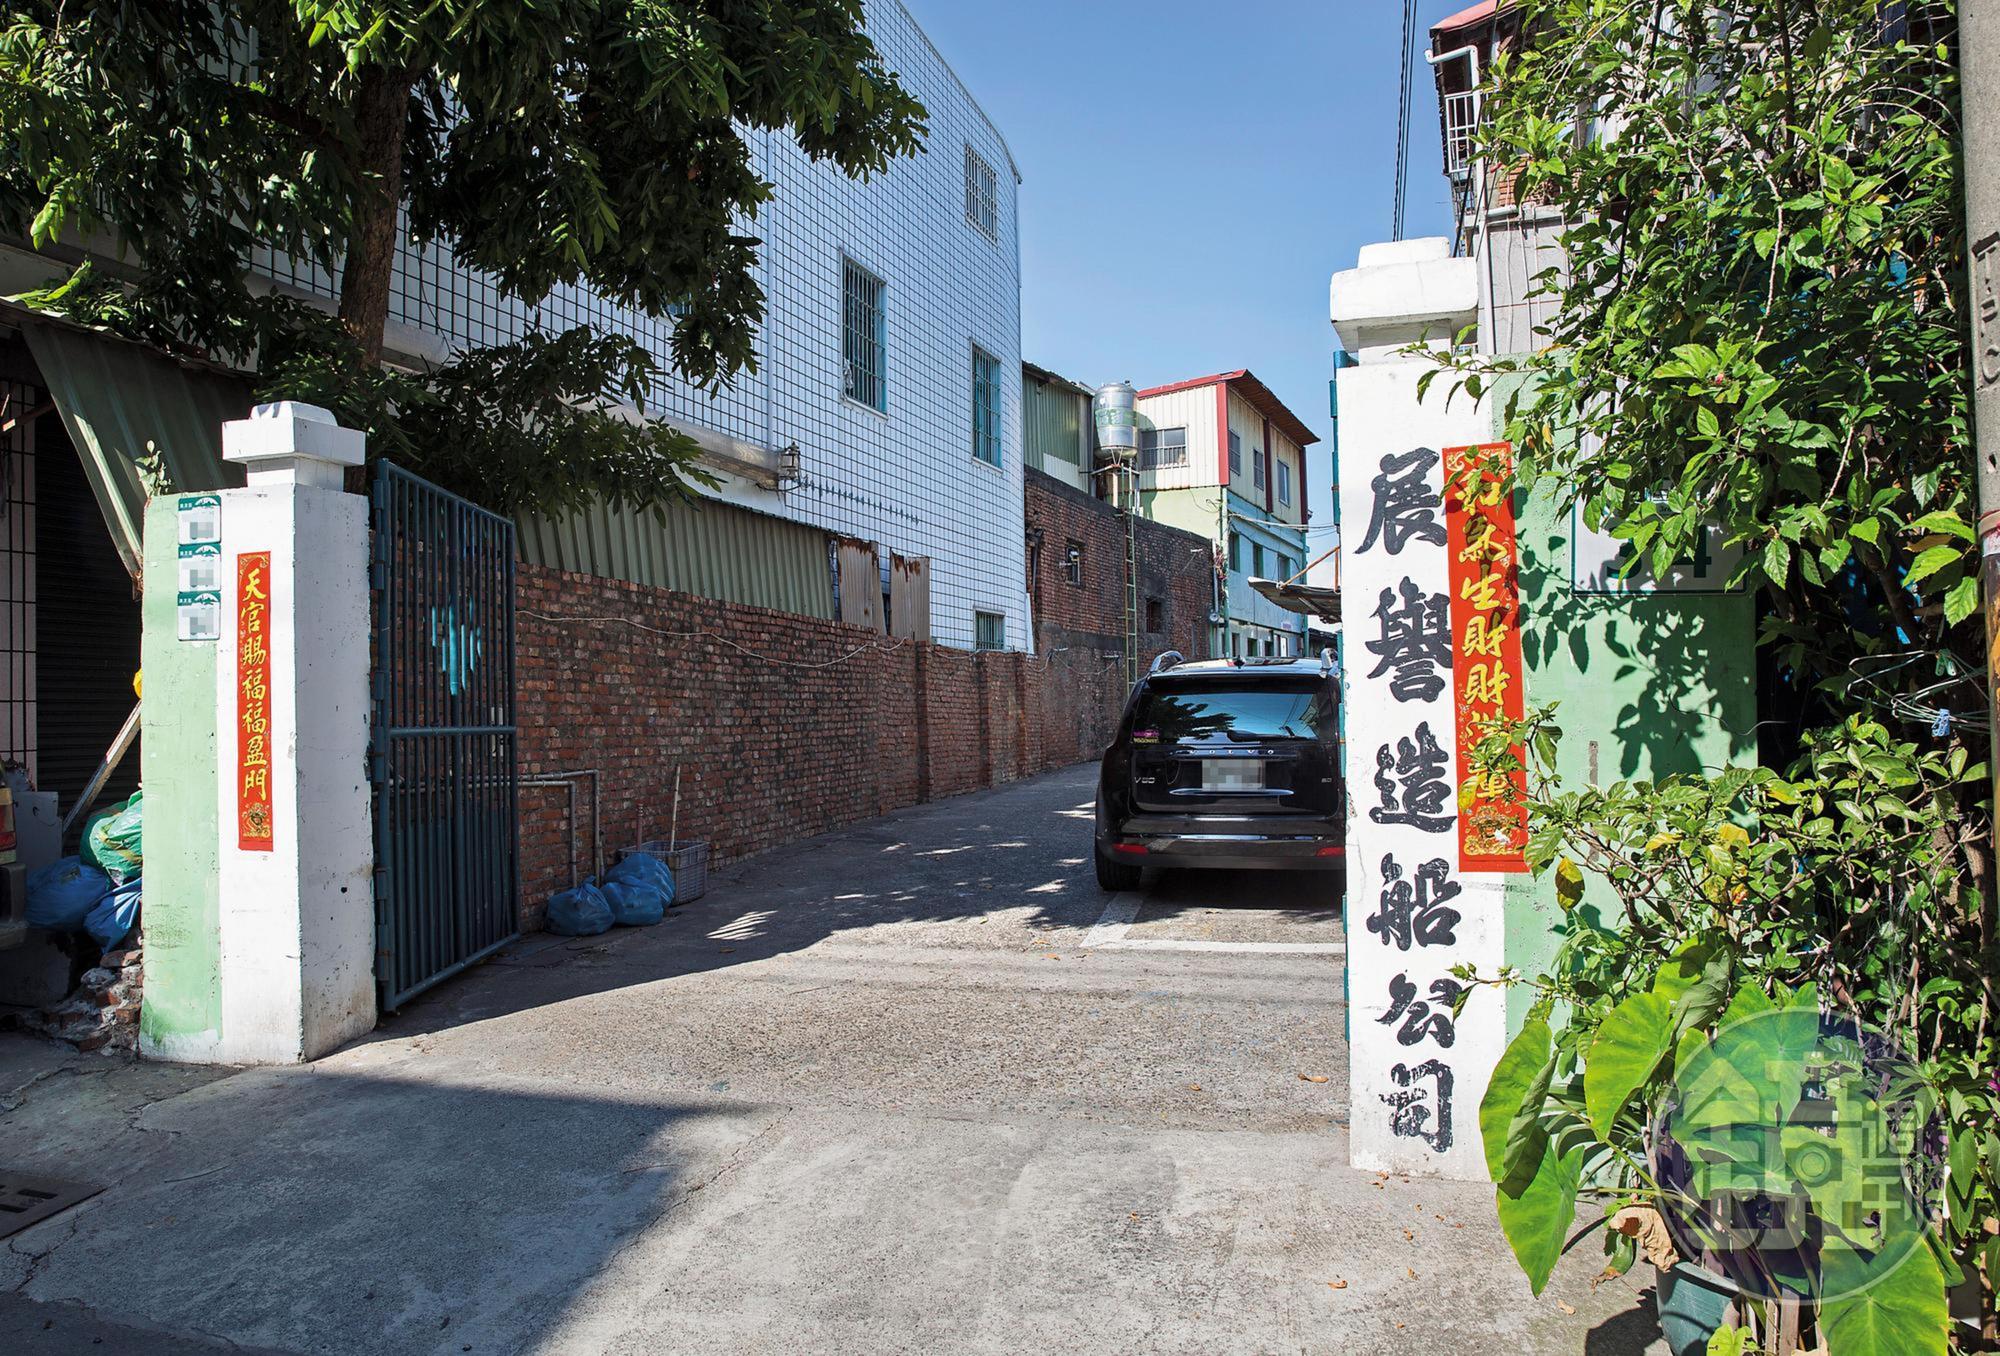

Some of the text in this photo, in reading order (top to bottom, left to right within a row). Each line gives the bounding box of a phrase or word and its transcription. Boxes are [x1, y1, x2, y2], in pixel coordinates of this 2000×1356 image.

[241, 568, 267, 801] 天官賜福福盈門
[1353, 446, 1463, 1154] 展譽造船公司
